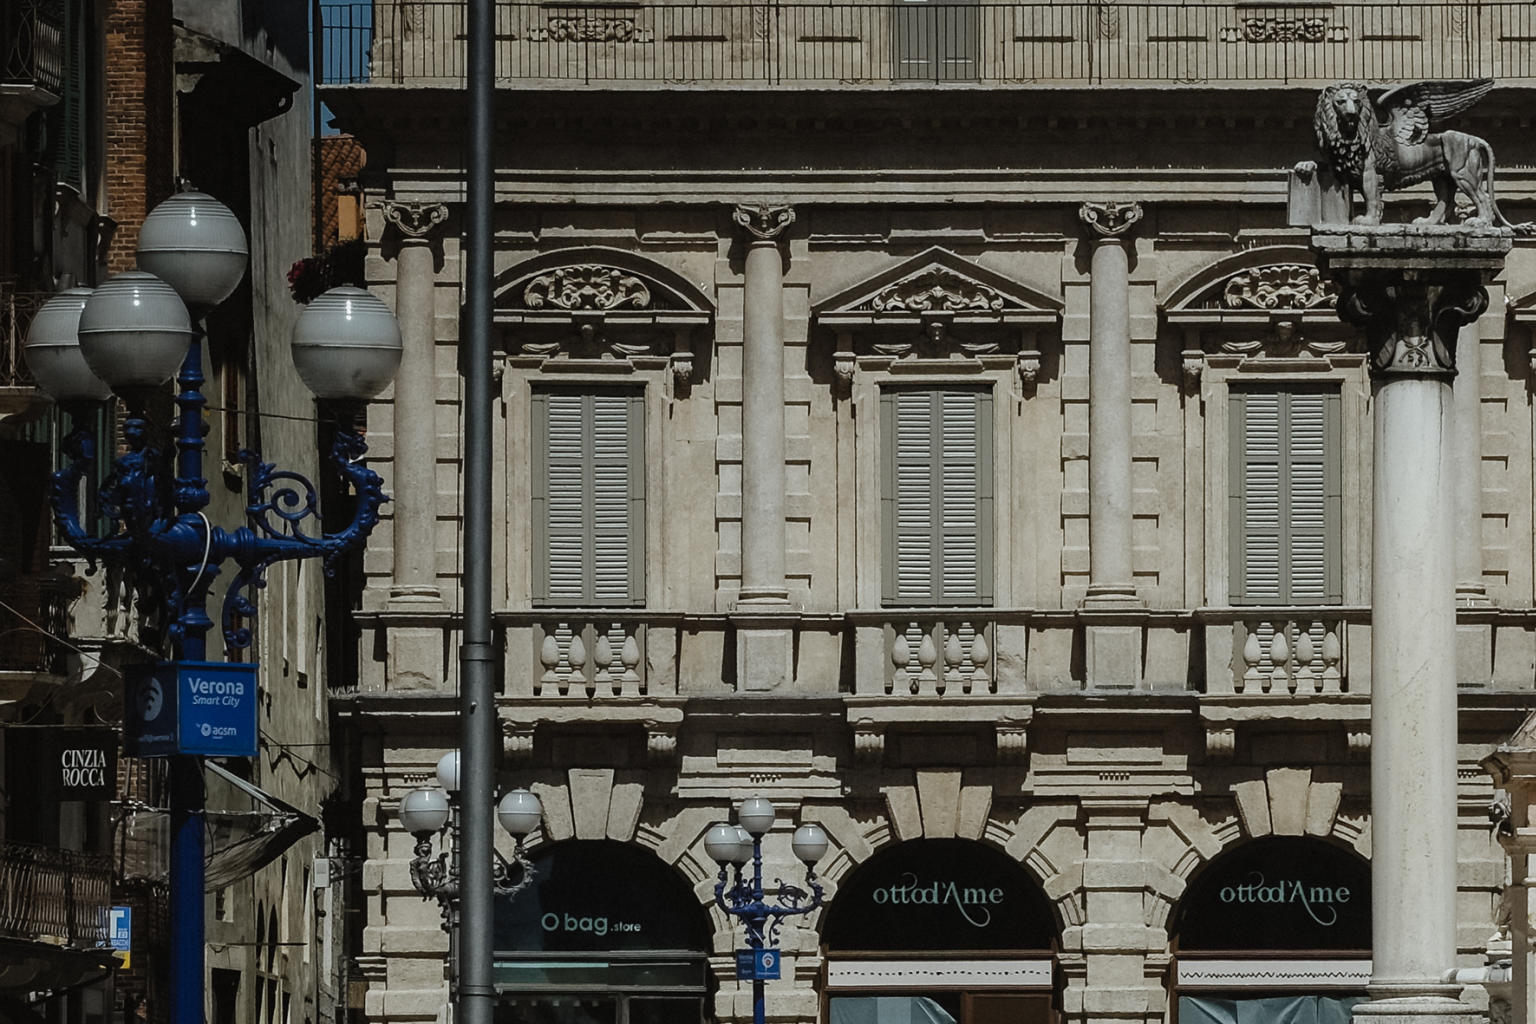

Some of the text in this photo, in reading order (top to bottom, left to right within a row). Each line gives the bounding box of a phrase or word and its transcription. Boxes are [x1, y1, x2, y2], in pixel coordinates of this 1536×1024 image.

[187, 677, 244, 695] Verona
[192, 695, 240, 708] Smart City
[61, 749, 107, 768] CINZIA
[62, 767, 105, 787] ROCCA
[541, 912, 560, 931] O
[564, 912, 608, 936] bag
